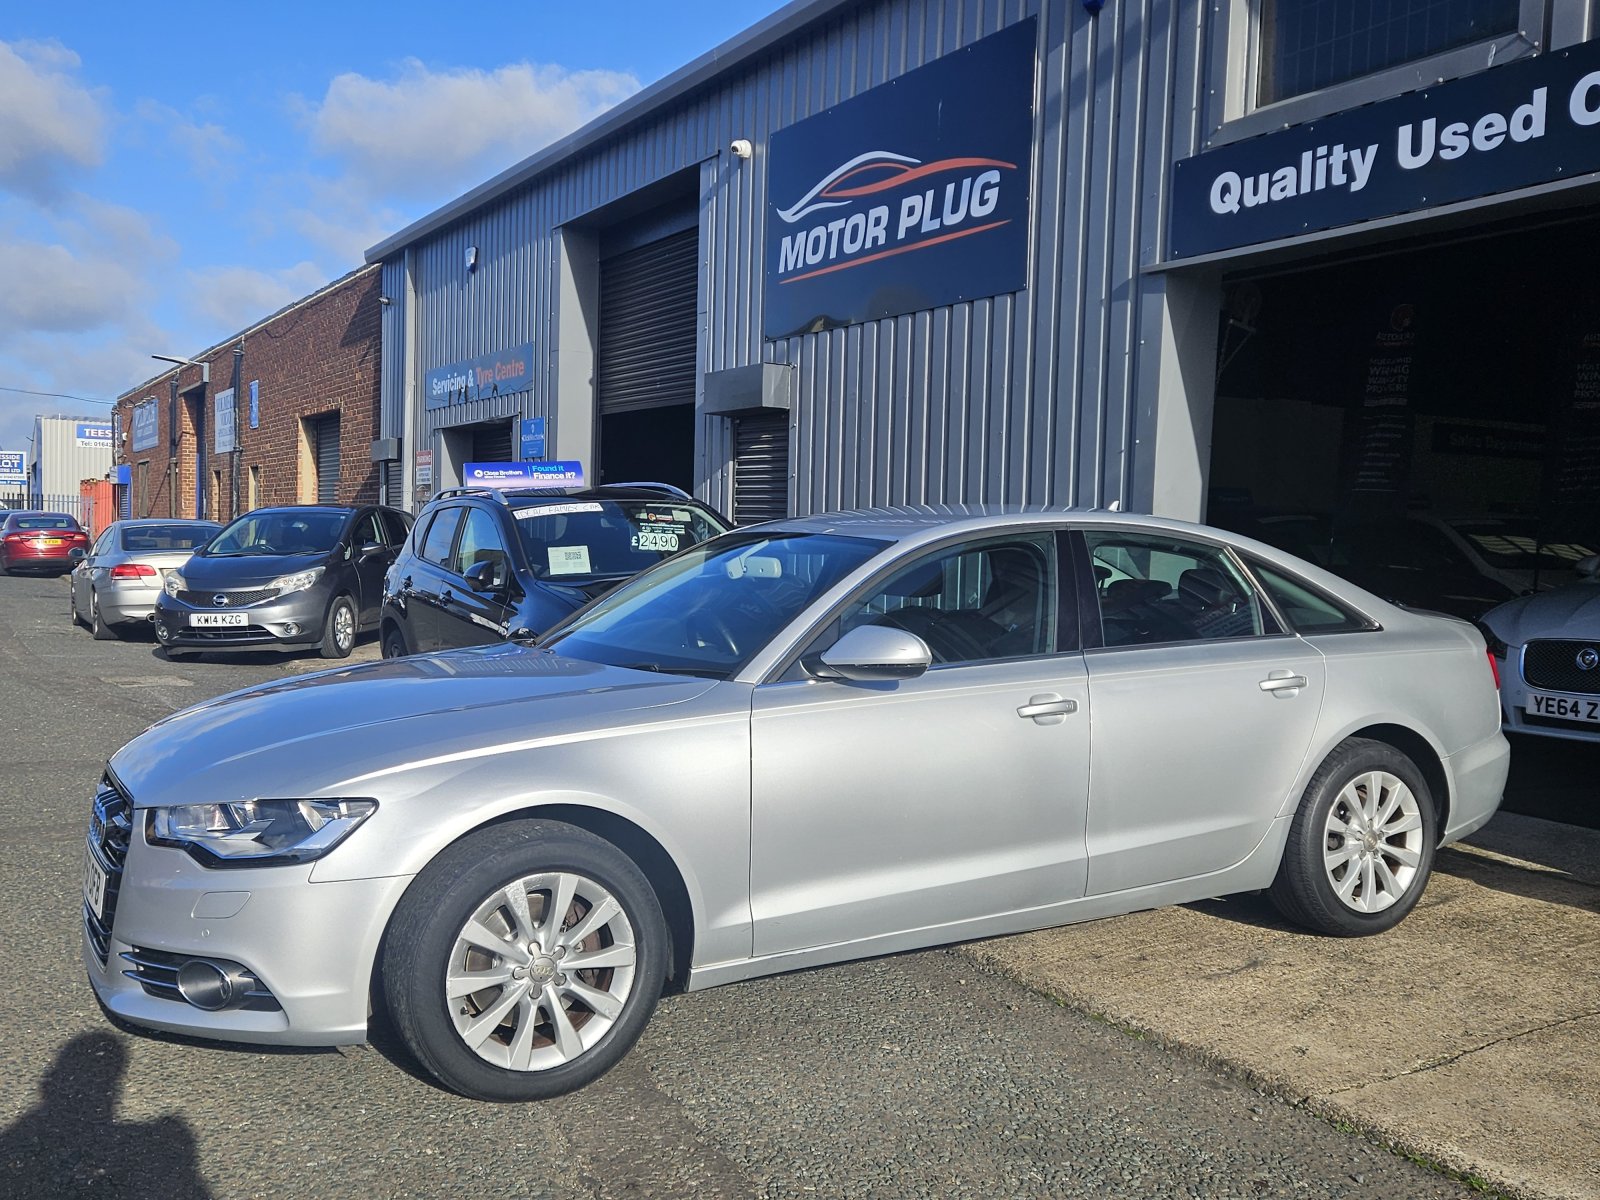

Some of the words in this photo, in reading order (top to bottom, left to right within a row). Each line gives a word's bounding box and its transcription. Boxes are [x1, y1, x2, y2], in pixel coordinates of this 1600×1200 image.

[1209, 143, 1379, 215] Quality
[1397, 86, 1548, 170] Used
[778, 205, 890, 274] MOTOR
[897, 169, 1001, 240] PLUG
[432, 372, 466, 395] Servicing
[467, 369, 474, 388] &
[476, 367, 494, 389] Tyre
[495, 359, 525, 381] Centre
[533, 472, 564, 480] Finance
[196, 615, 218, 625] KW14
[221, 614, 242, 625] KZG
[1533, 695, 1581, 718] YE64
[1586, 701, 1599, 720] Z
